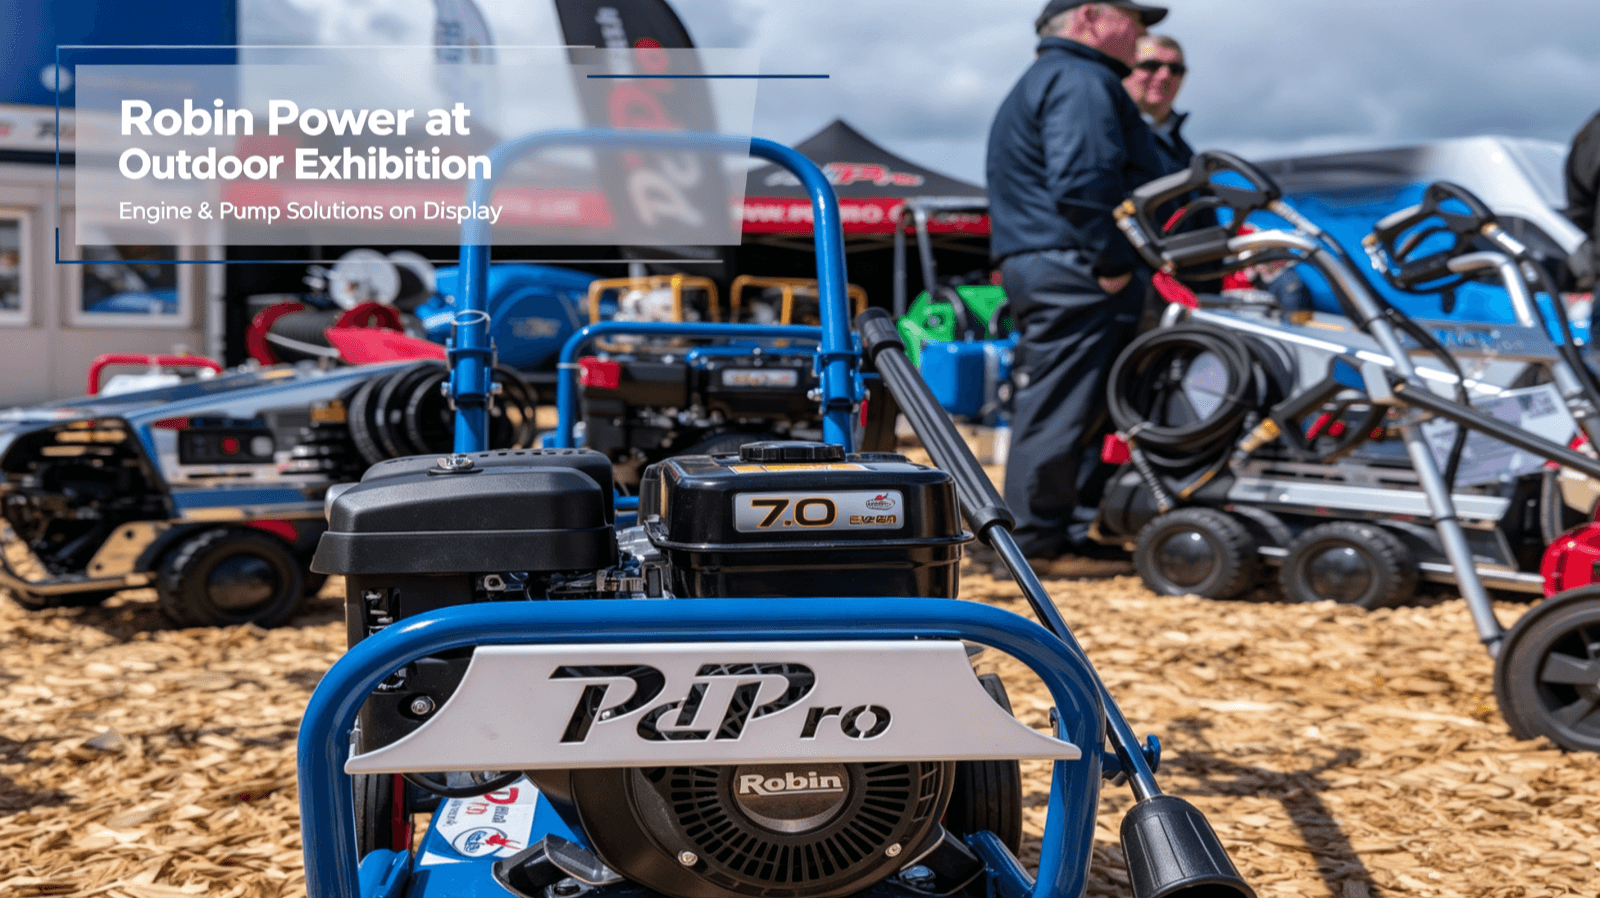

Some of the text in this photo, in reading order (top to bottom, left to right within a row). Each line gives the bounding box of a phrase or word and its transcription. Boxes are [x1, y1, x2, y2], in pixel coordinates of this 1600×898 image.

[750, 498, 838, 528] 7.0
[549, 663, 892, 744] PdPro
[739, 771, 843, 795] Robin
